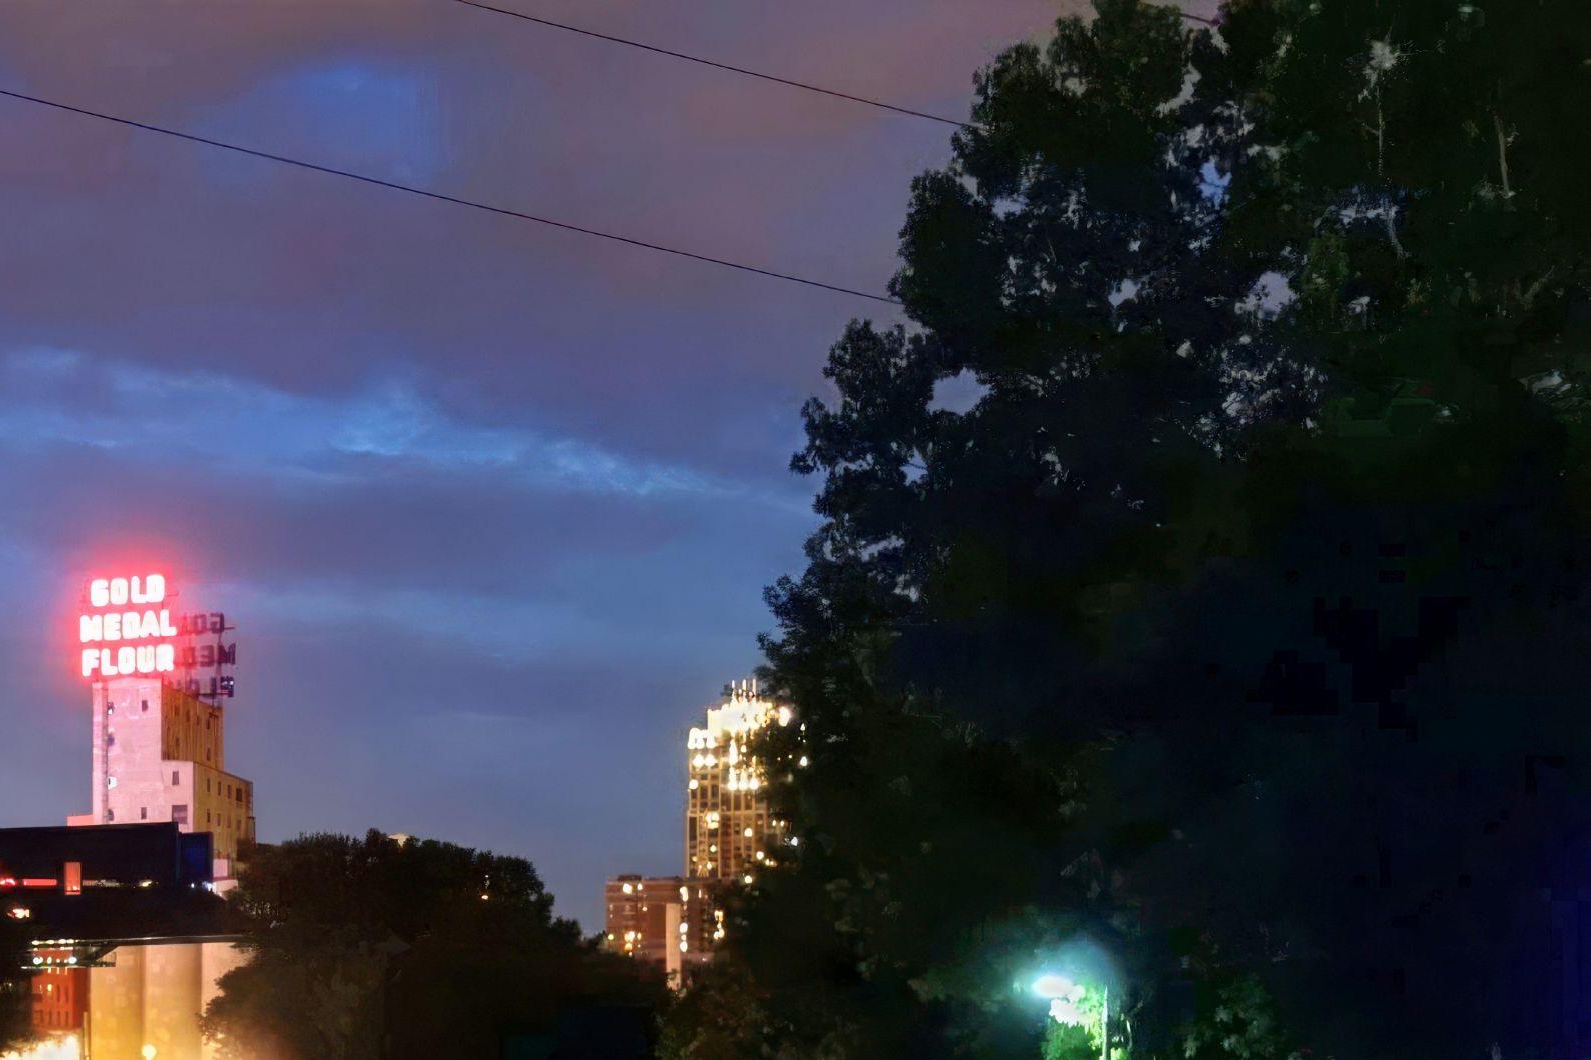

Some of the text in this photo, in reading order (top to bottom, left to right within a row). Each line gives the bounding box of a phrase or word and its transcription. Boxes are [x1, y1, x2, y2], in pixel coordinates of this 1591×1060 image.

[90, 574, 166, 607] GOLD
[79, 608, 177, 643] MEDAL
[81, 643, 175, 677] FLOUR
